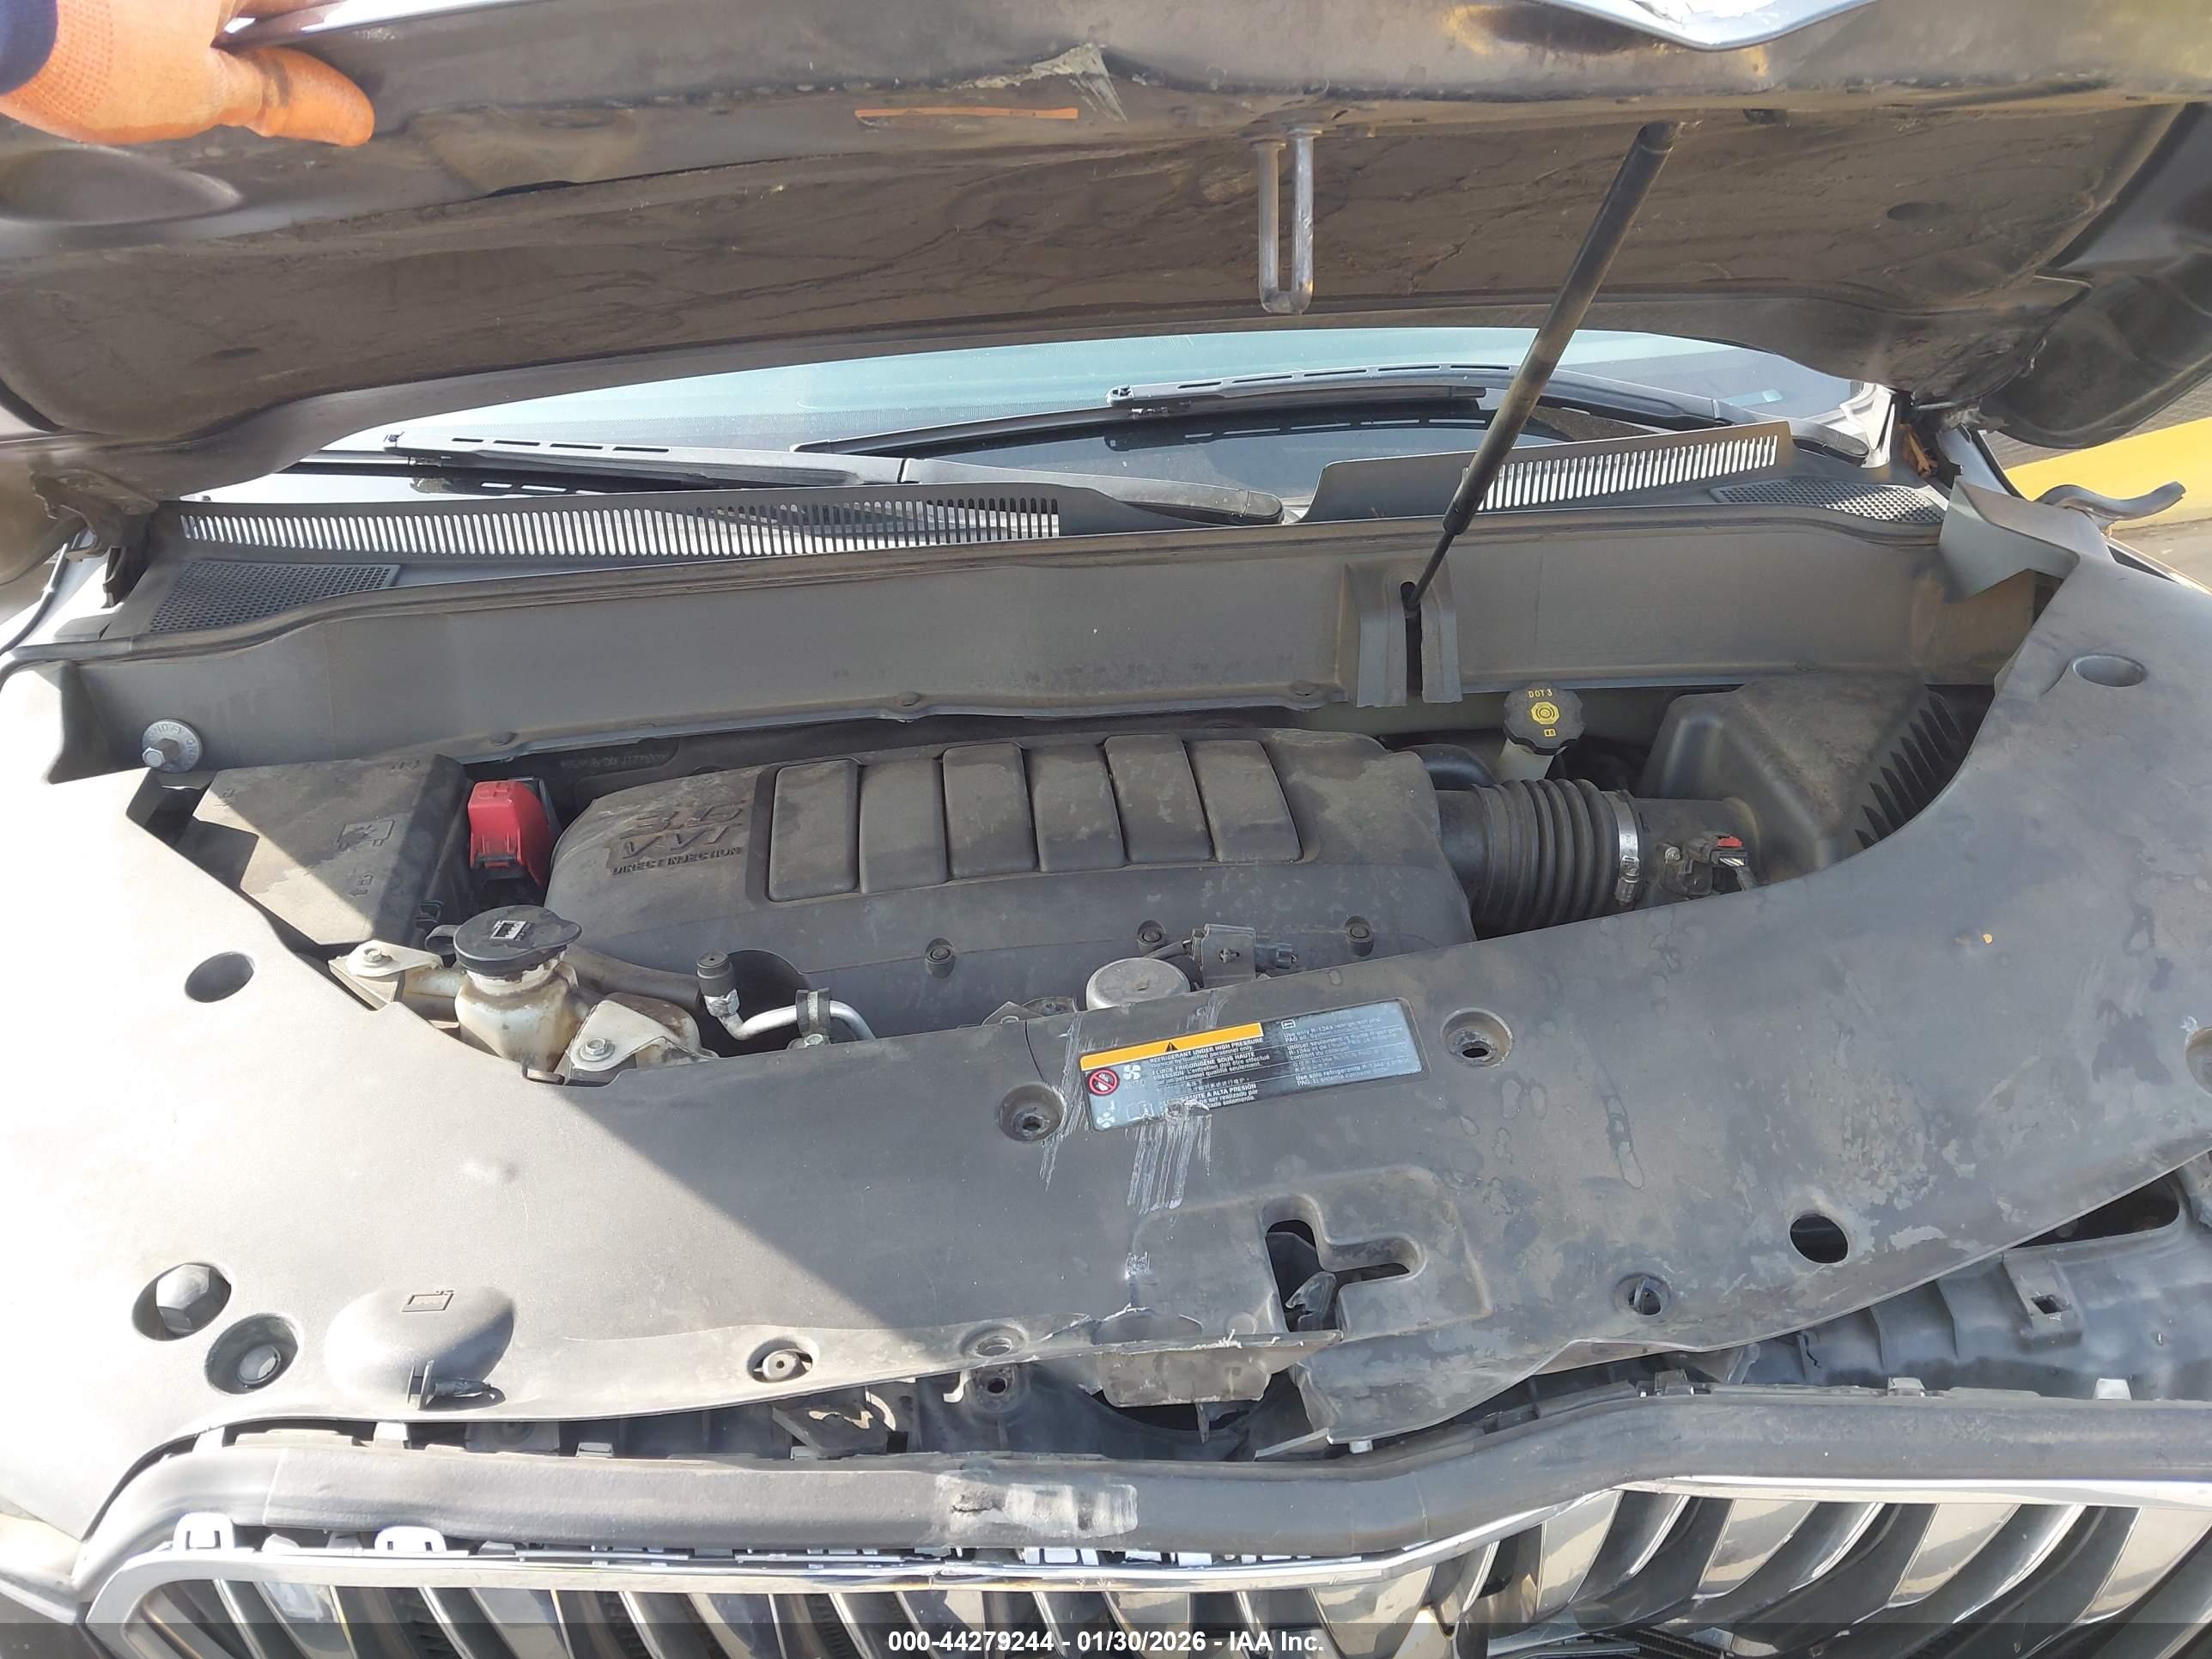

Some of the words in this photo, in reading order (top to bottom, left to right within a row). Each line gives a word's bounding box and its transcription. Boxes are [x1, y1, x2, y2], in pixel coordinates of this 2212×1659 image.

[1528, 690, 1546, 698] DOT
[612, 859, 663, 876] DIRECT
[666, 847, 744, 866] INJECTION
[1149, 1050, 1191, 1063] REFRIGERANT
[1193, 1046, 1214, 1055] UNDER
[1231, 1037, 1263, 1048] PRESSURE
[1209, 1047, 1238, 1058] personnel
[1152, 1066, 1173, 1075] FLUIDE
[1235, 1051, 1255, 1060] HAUTE
[1188, 1063, 1218, 1074] L'entretien
[1245, 1054, 1269, 1063] effectué
[1229, 1082, 1256, 1093] PRESIÓN
[1219, 1091, 1247, 1101] realizado
